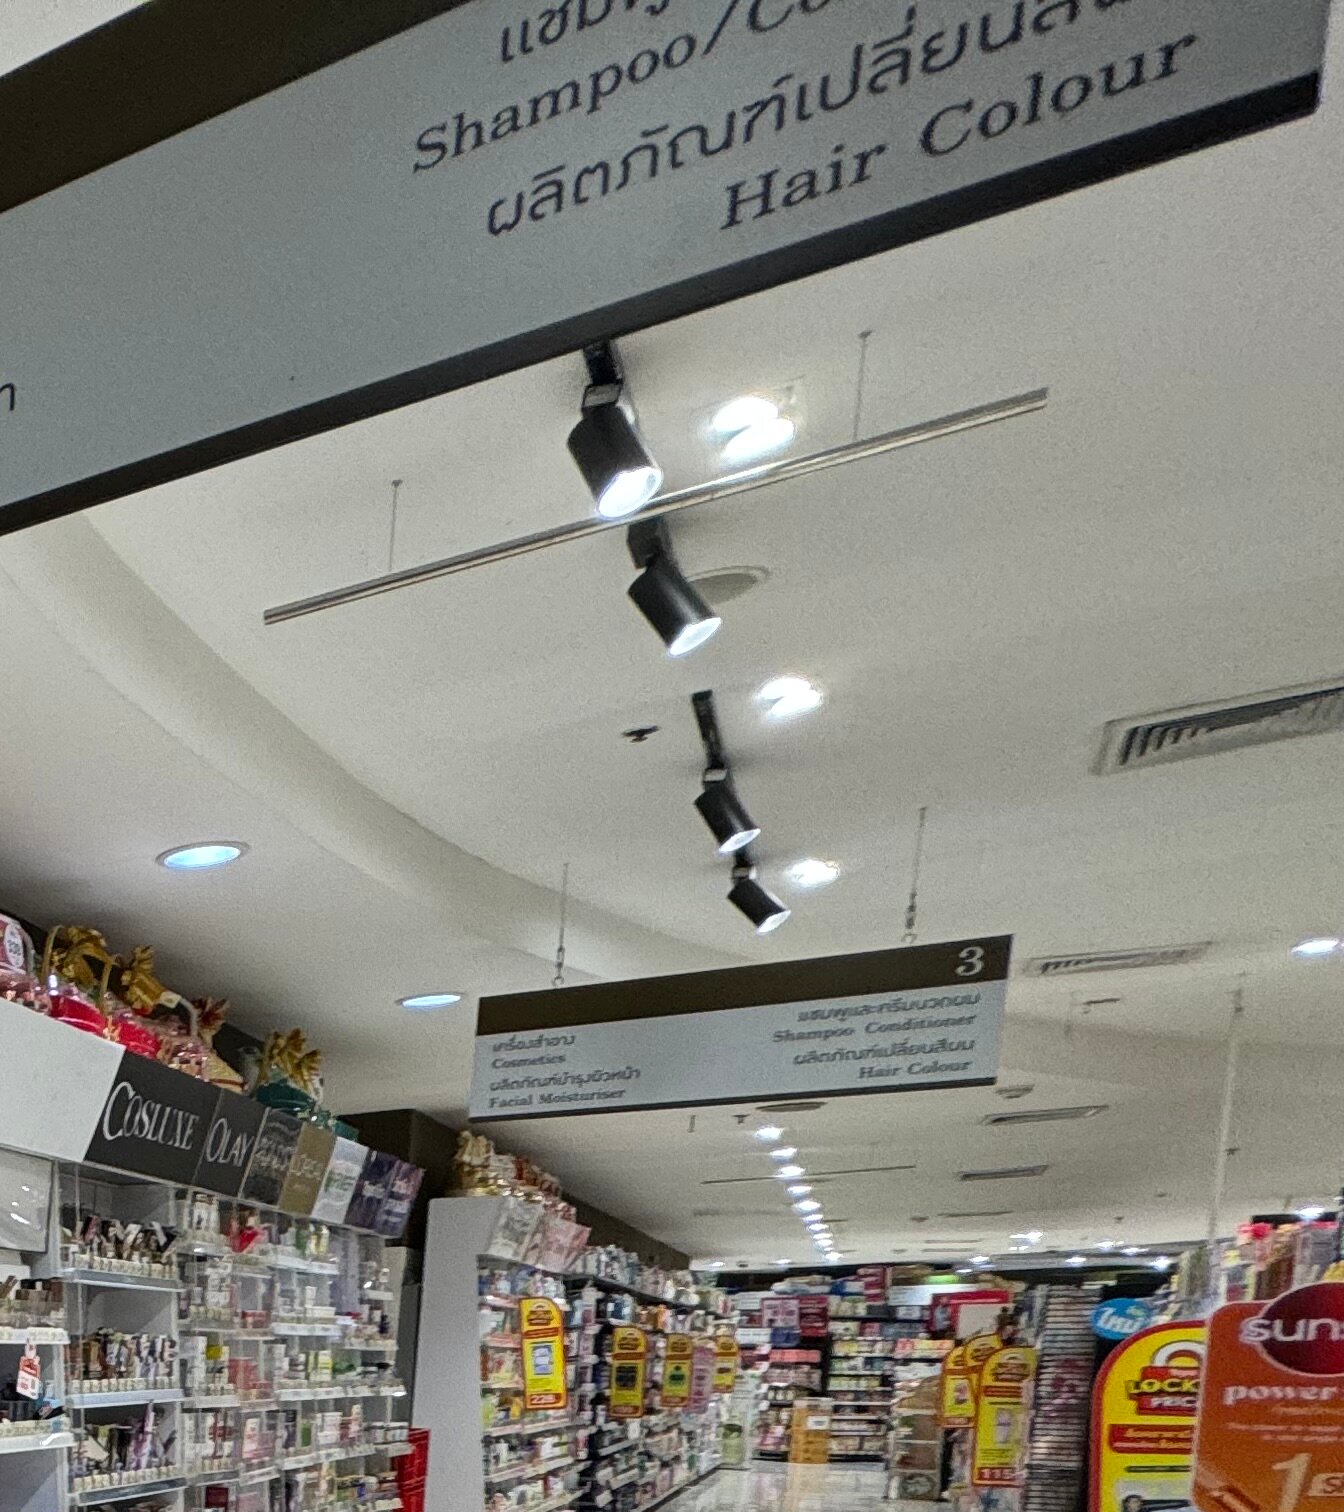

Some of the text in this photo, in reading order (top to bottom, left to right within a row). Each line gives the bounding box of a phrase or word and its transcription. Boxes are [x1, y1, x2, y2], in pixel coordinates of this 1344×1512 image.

[718, 30, 1197, 230] Hair Colour
[955, 946, 986, 977] 3
[491, 1052, 567, 1070] Cosmetics
[488, 1086, 626, 1109] Facial Moisturiser
[205, 1117, 254, 1168] OLAY
